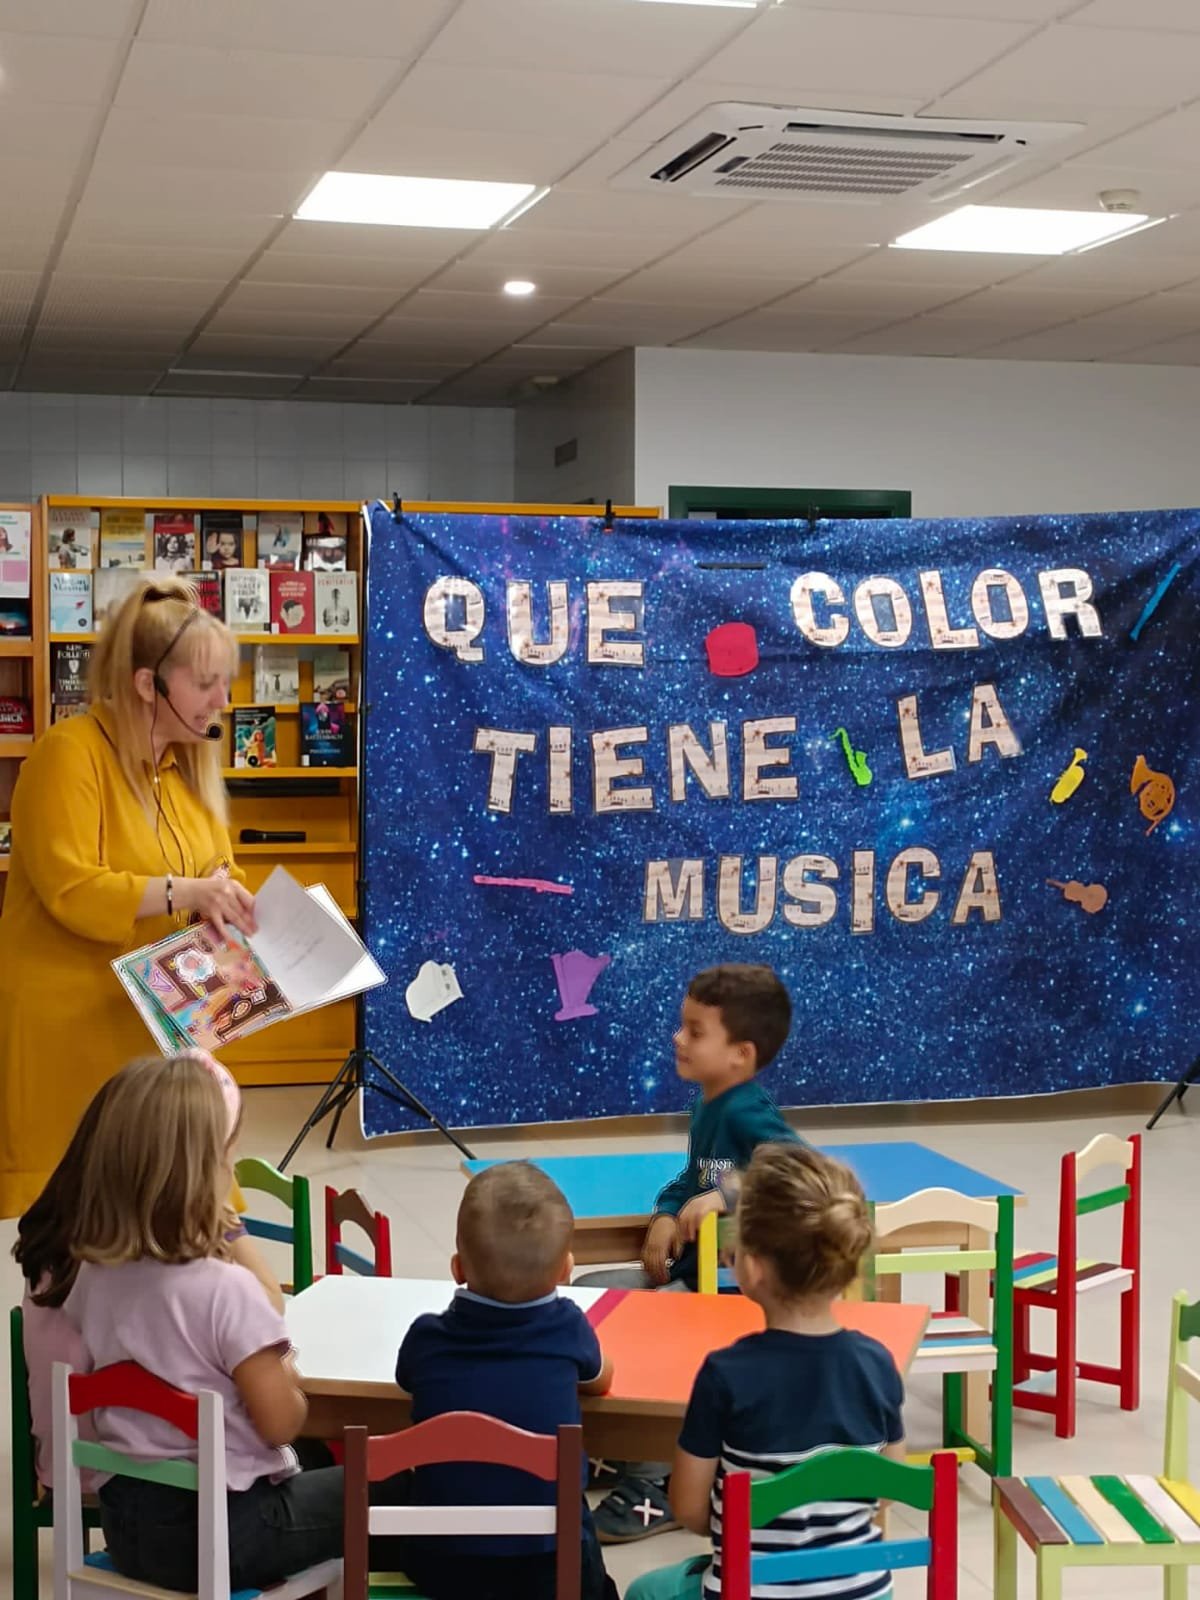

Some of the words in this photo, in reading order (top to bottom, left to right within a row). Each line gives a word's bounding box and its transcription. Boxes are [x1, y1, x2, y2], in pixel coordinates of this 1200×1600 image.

[423, 576, 646, 665] QUE
[790, 569, 1103, 649] COLOR
[473, 718, 798, 814] TIENE
[897, 683, 1023, 780] LA
[643, 848, 1002, 934] MUSICA
